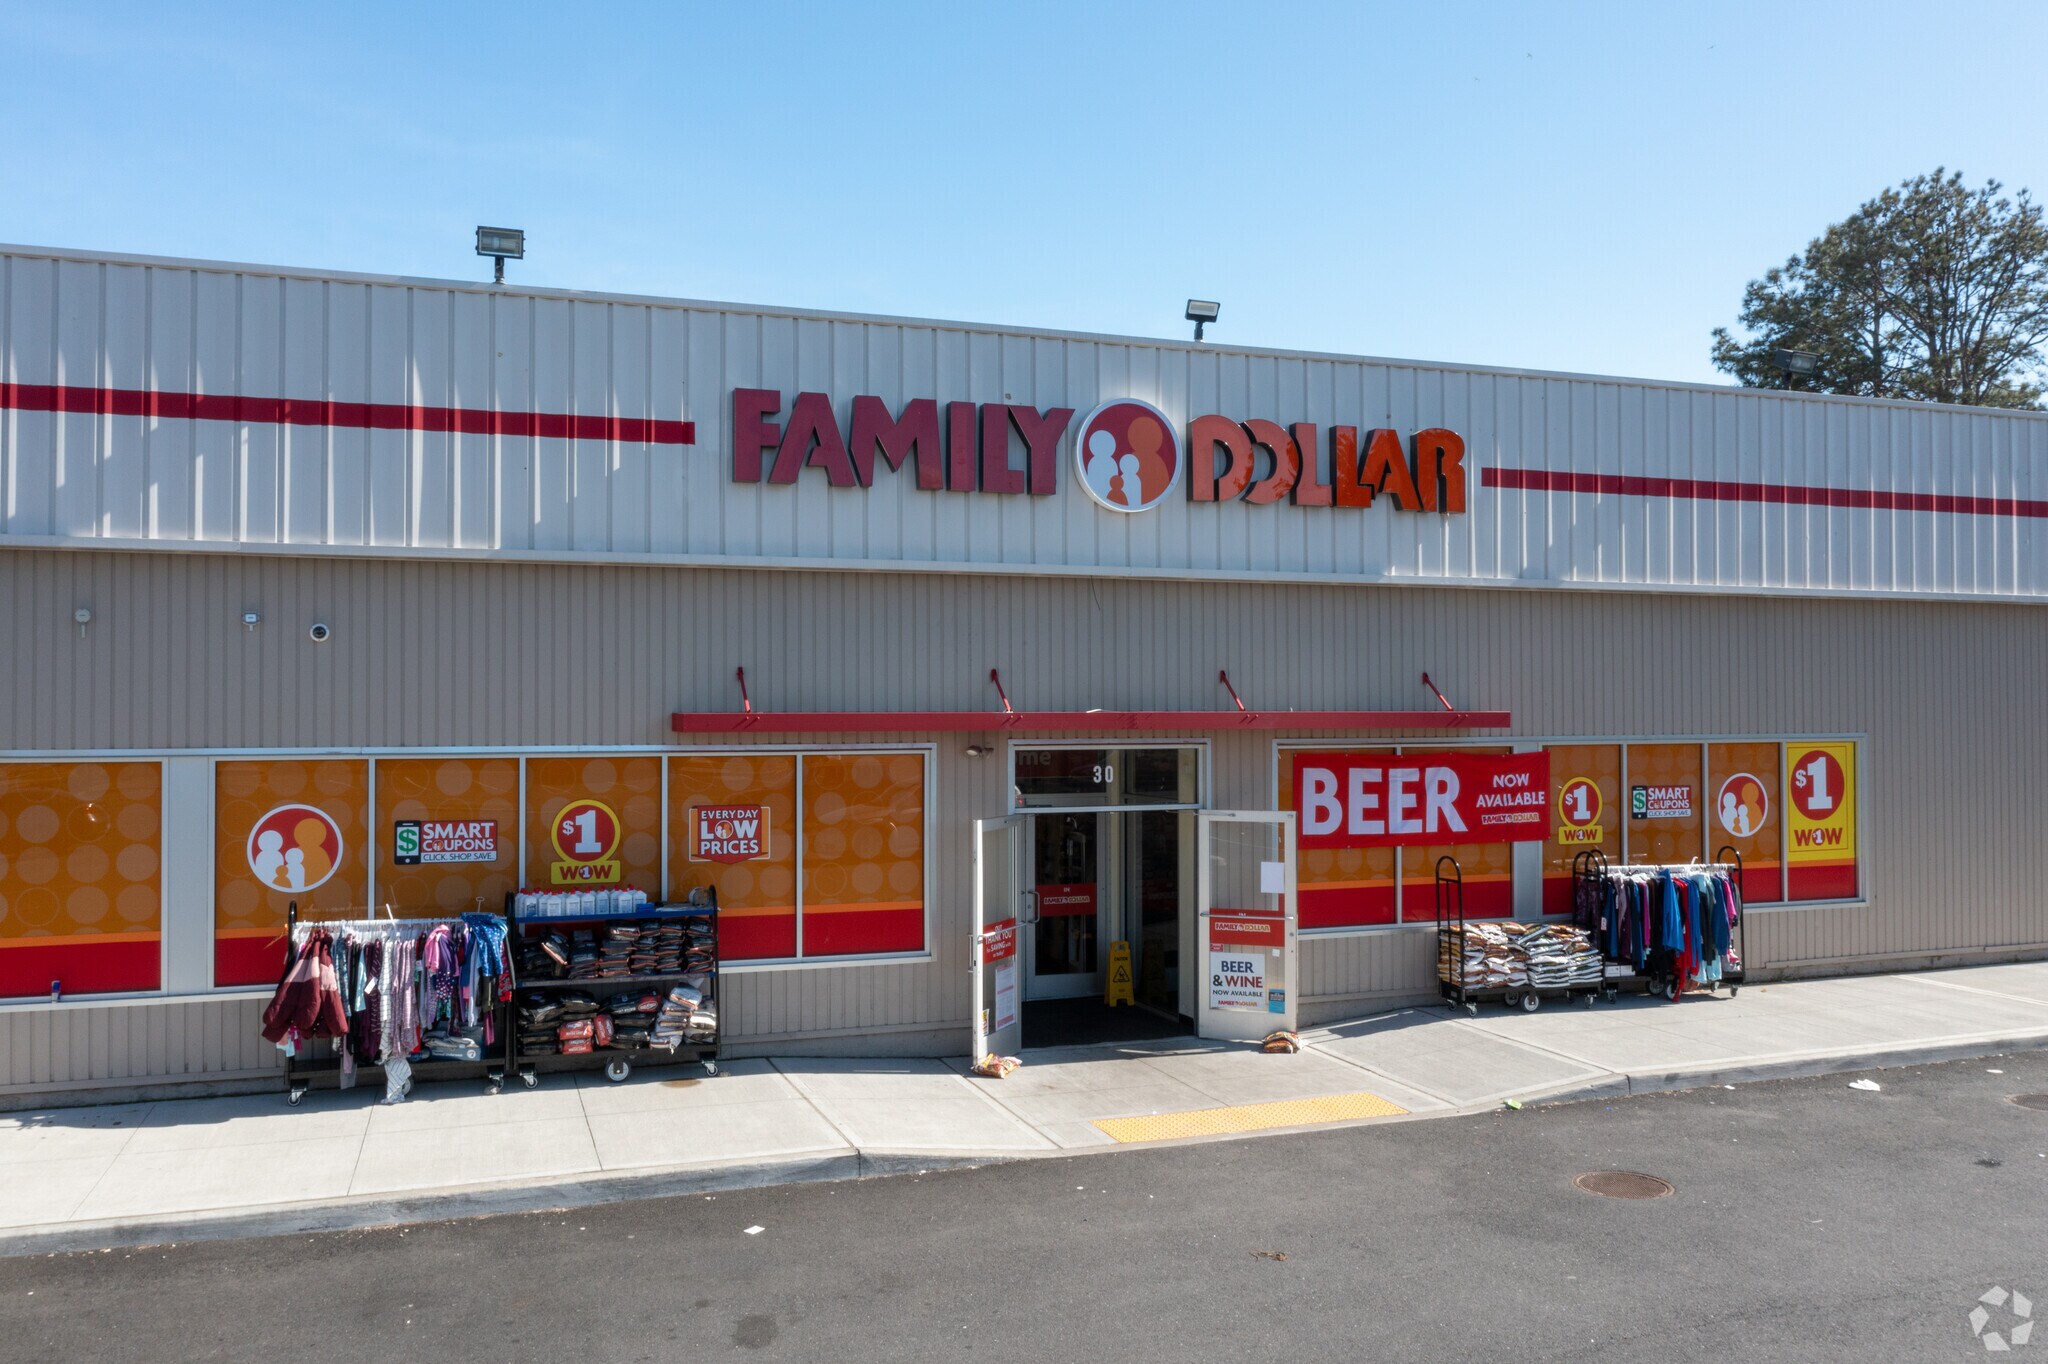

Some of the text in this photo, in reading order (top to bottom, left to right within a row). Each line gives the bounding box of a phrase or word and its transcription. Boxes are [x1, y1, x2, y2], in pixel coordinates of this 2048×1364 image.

[732, 388, 1466, 513] FAMILY DOLLAR
[1093, 766, 1114, 782] 30
[1493, 773, 1529, 788] NOW
[1796, 757, 1832, 810] $1
[1302, 767, 1468, 835] BEER
[1476, 791, 1546, 808] AVAILABLE
[1648, 788, 1689, 800] SMART
[1565, 785, 1591, 820] $1
[1648, 800, 1689, 809] COUPONS
[702, 810, 758, 819] EVERYDAY
[1482, 812, 1540, 825] FAMILY DOLLAR
[423, 822, 494, 840] SMART
[562, 810, 602, 854] $1
[700, 820, 758, 839] LOW
[1564, 829, 1598, 841] WOW
[1794, 828, 1842, 846] WOW
[423, 839, 494, 852] COUPONS
[700, 840, 759, 854] PRICES
[560, 865, 612, 880] WOW
[1215, 922, 1238, 931] FAMILY
[986, 930, 1012, 945] THANK YOU
[1222, 960, 1254, 973] BEER
[1213, 974, 1263, 988] & WINE
